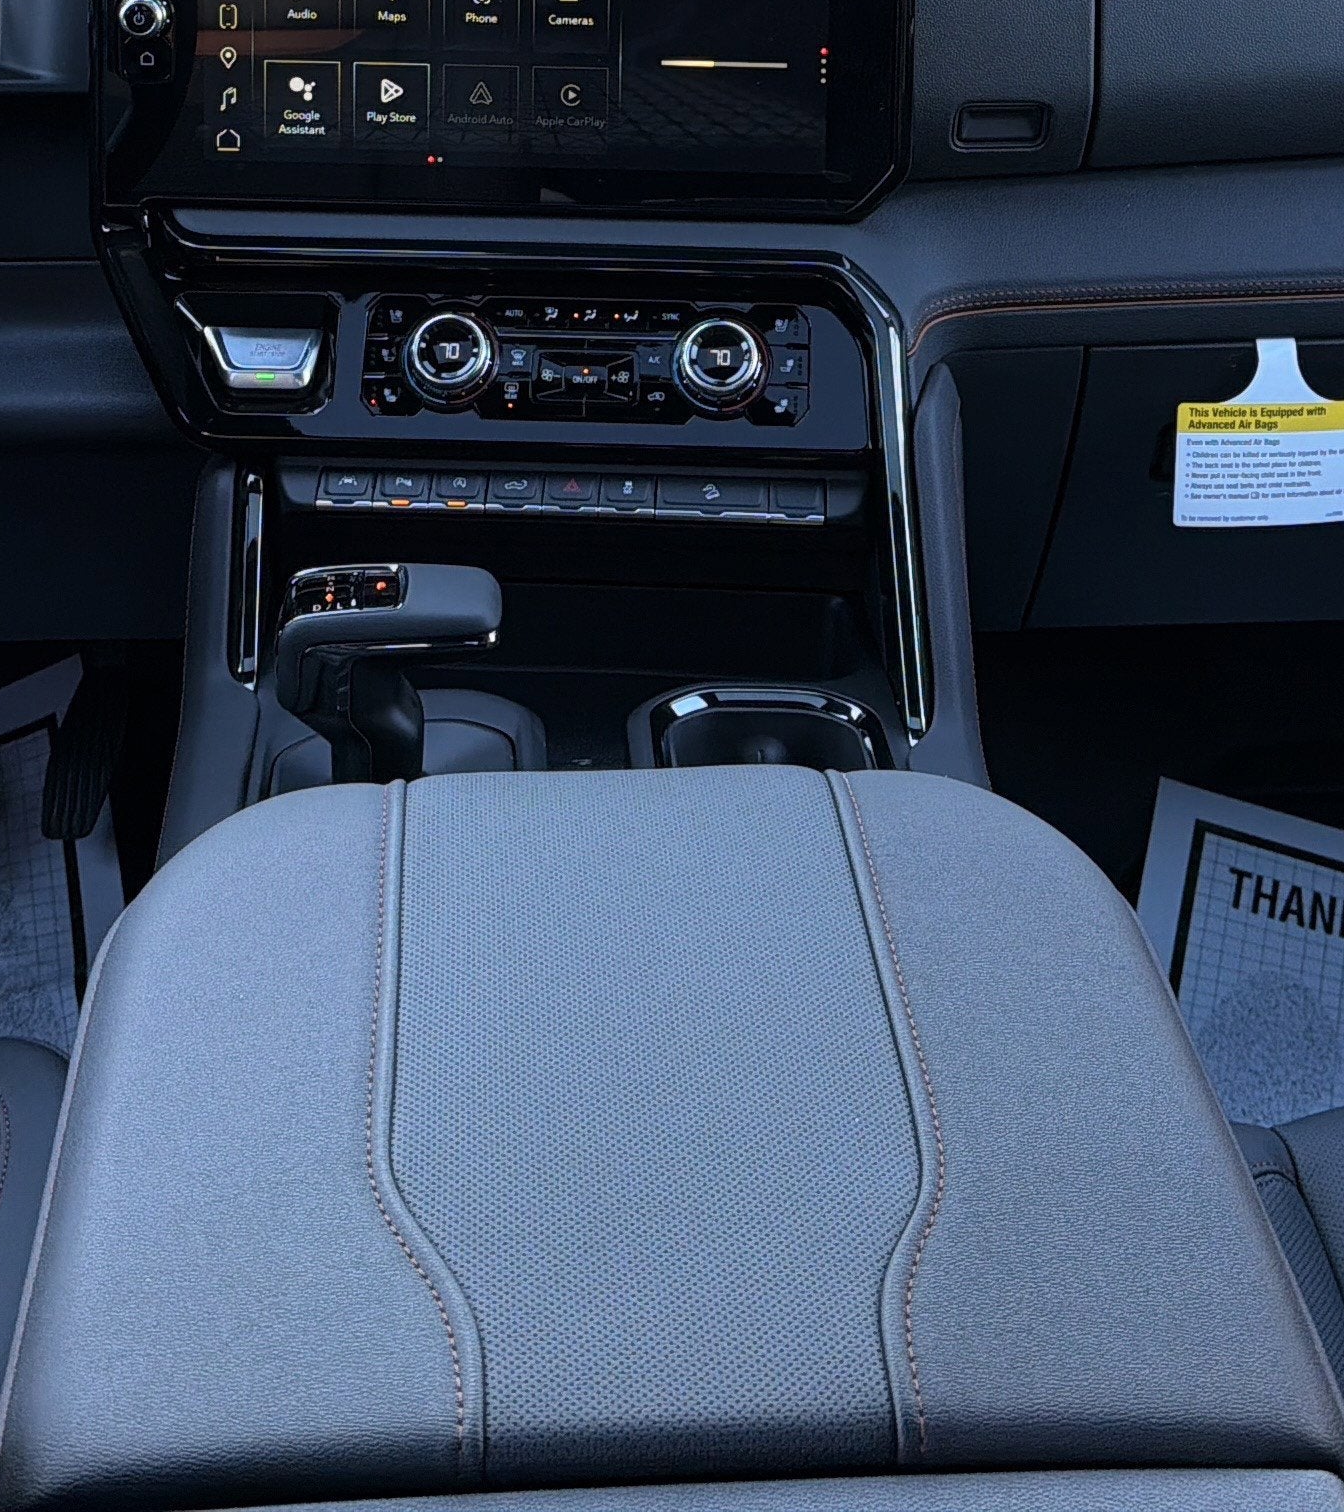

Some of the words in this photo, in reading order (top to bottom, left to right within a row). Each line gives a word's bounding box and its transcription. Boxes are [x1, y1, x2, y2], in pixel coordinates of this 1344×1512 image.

[287, 8, 317, 21] Audio
[377, 10, 407, 24] Maps
[465, 12, 498, 25] Phone
[548, 14, 594, 27] Cameras
[282, 109, 321, 124] Google
[366, 111, 388, 125] Play
[389, 111, 417, 124] Store
[447, 113, 488, 126] Android
[490, 114, 514, 126] Auto
[535, 115, 567, 129] Apple
[278, 124, 326, 136] Assistant
[504, 309, 524, 318] AUTO
[439, 342, 460, 360] 70
[709, 349, 731, 367] 70
[1189, 407, 1209, 418] This
[1212, 407, 1247, 418] Vehicle
[1250, 407, 1258, 417] is
[1260, 406, 1304, 419] Equipped
[1306, 406, 1326, 417] with
[1188, 419, 1235, 430] Advanced
[1237, 419, 1251, 429] Air
[1254, 419, 1278, 432] Bags
